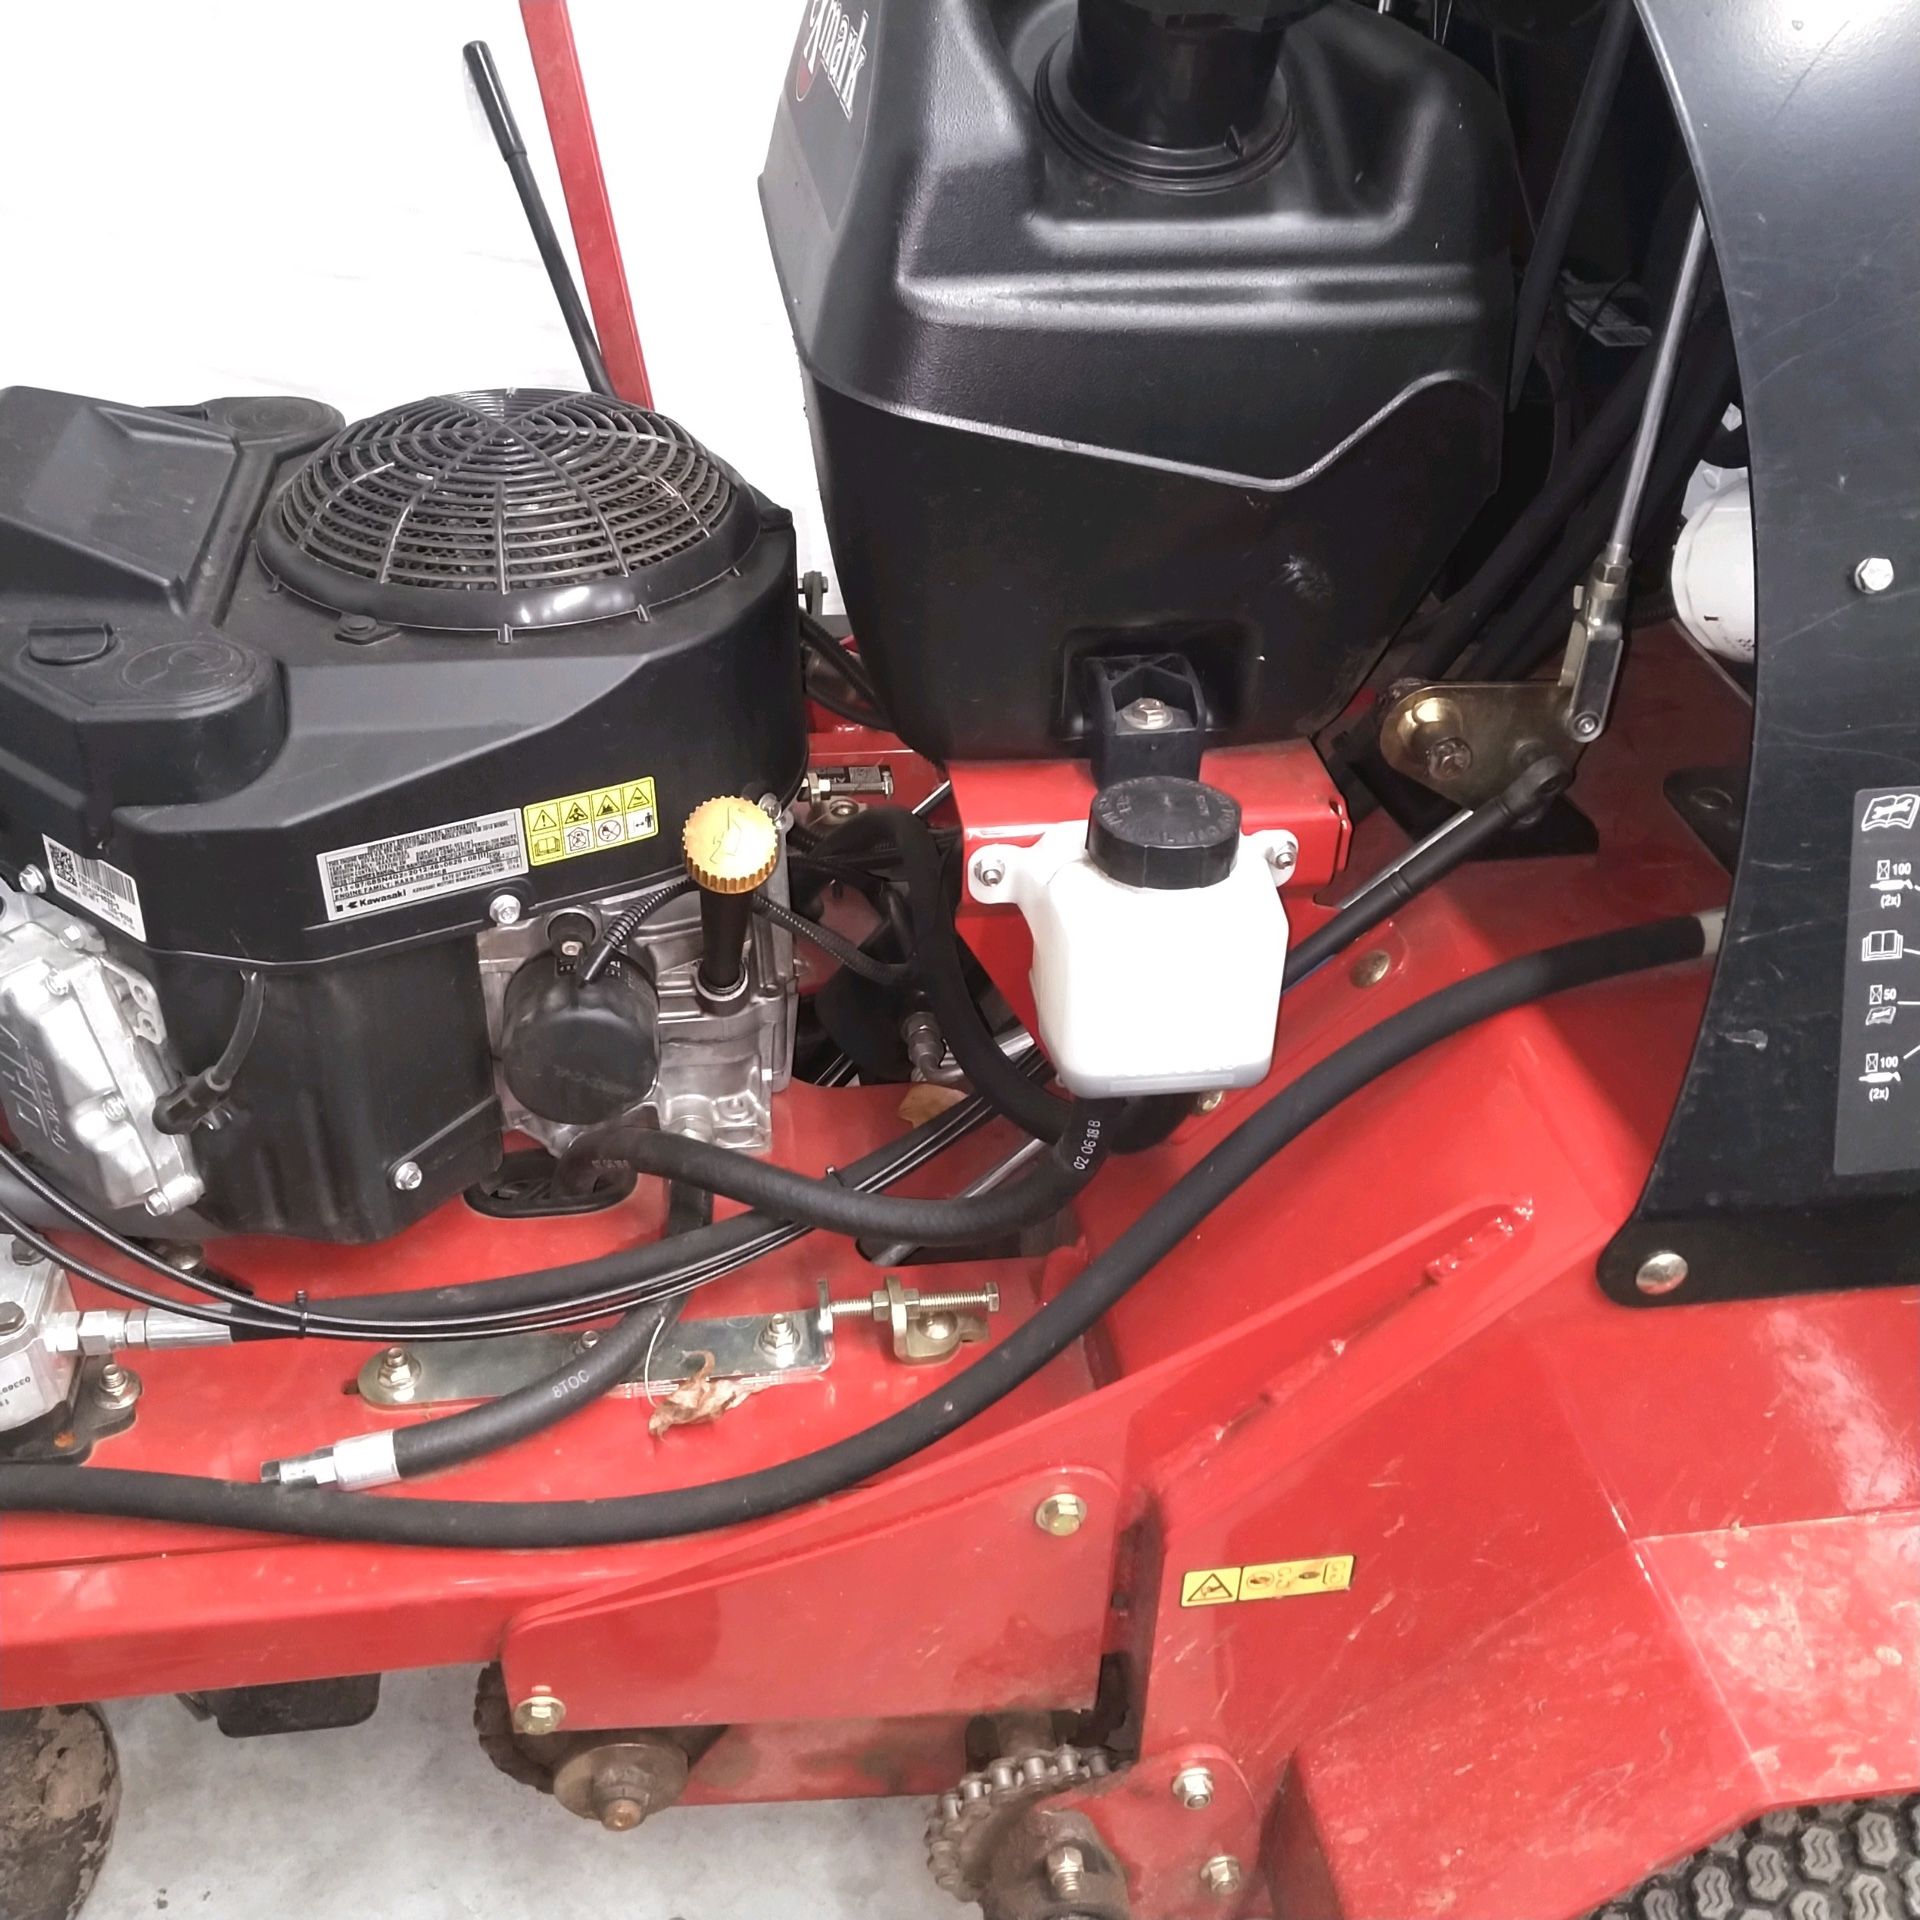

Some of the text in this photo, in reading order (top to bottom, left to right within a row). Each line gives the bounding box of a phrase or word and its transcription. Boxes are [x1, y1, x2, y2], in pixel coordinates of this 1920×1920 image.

[1892, 862, 1912, 876] 100
[359, 889, 406, 907] Kawasaki
[1880, 893, 1901, 909] (2x)
[1883, 988, 1897, 1001] 50
[1880, 1056, 1899, 1069] 100
[1869, 1086, 1890, 1102] (2x)
[1081, 1139, 1097, 1155] 06
[1073, 1156, 1090, 1170] 02
